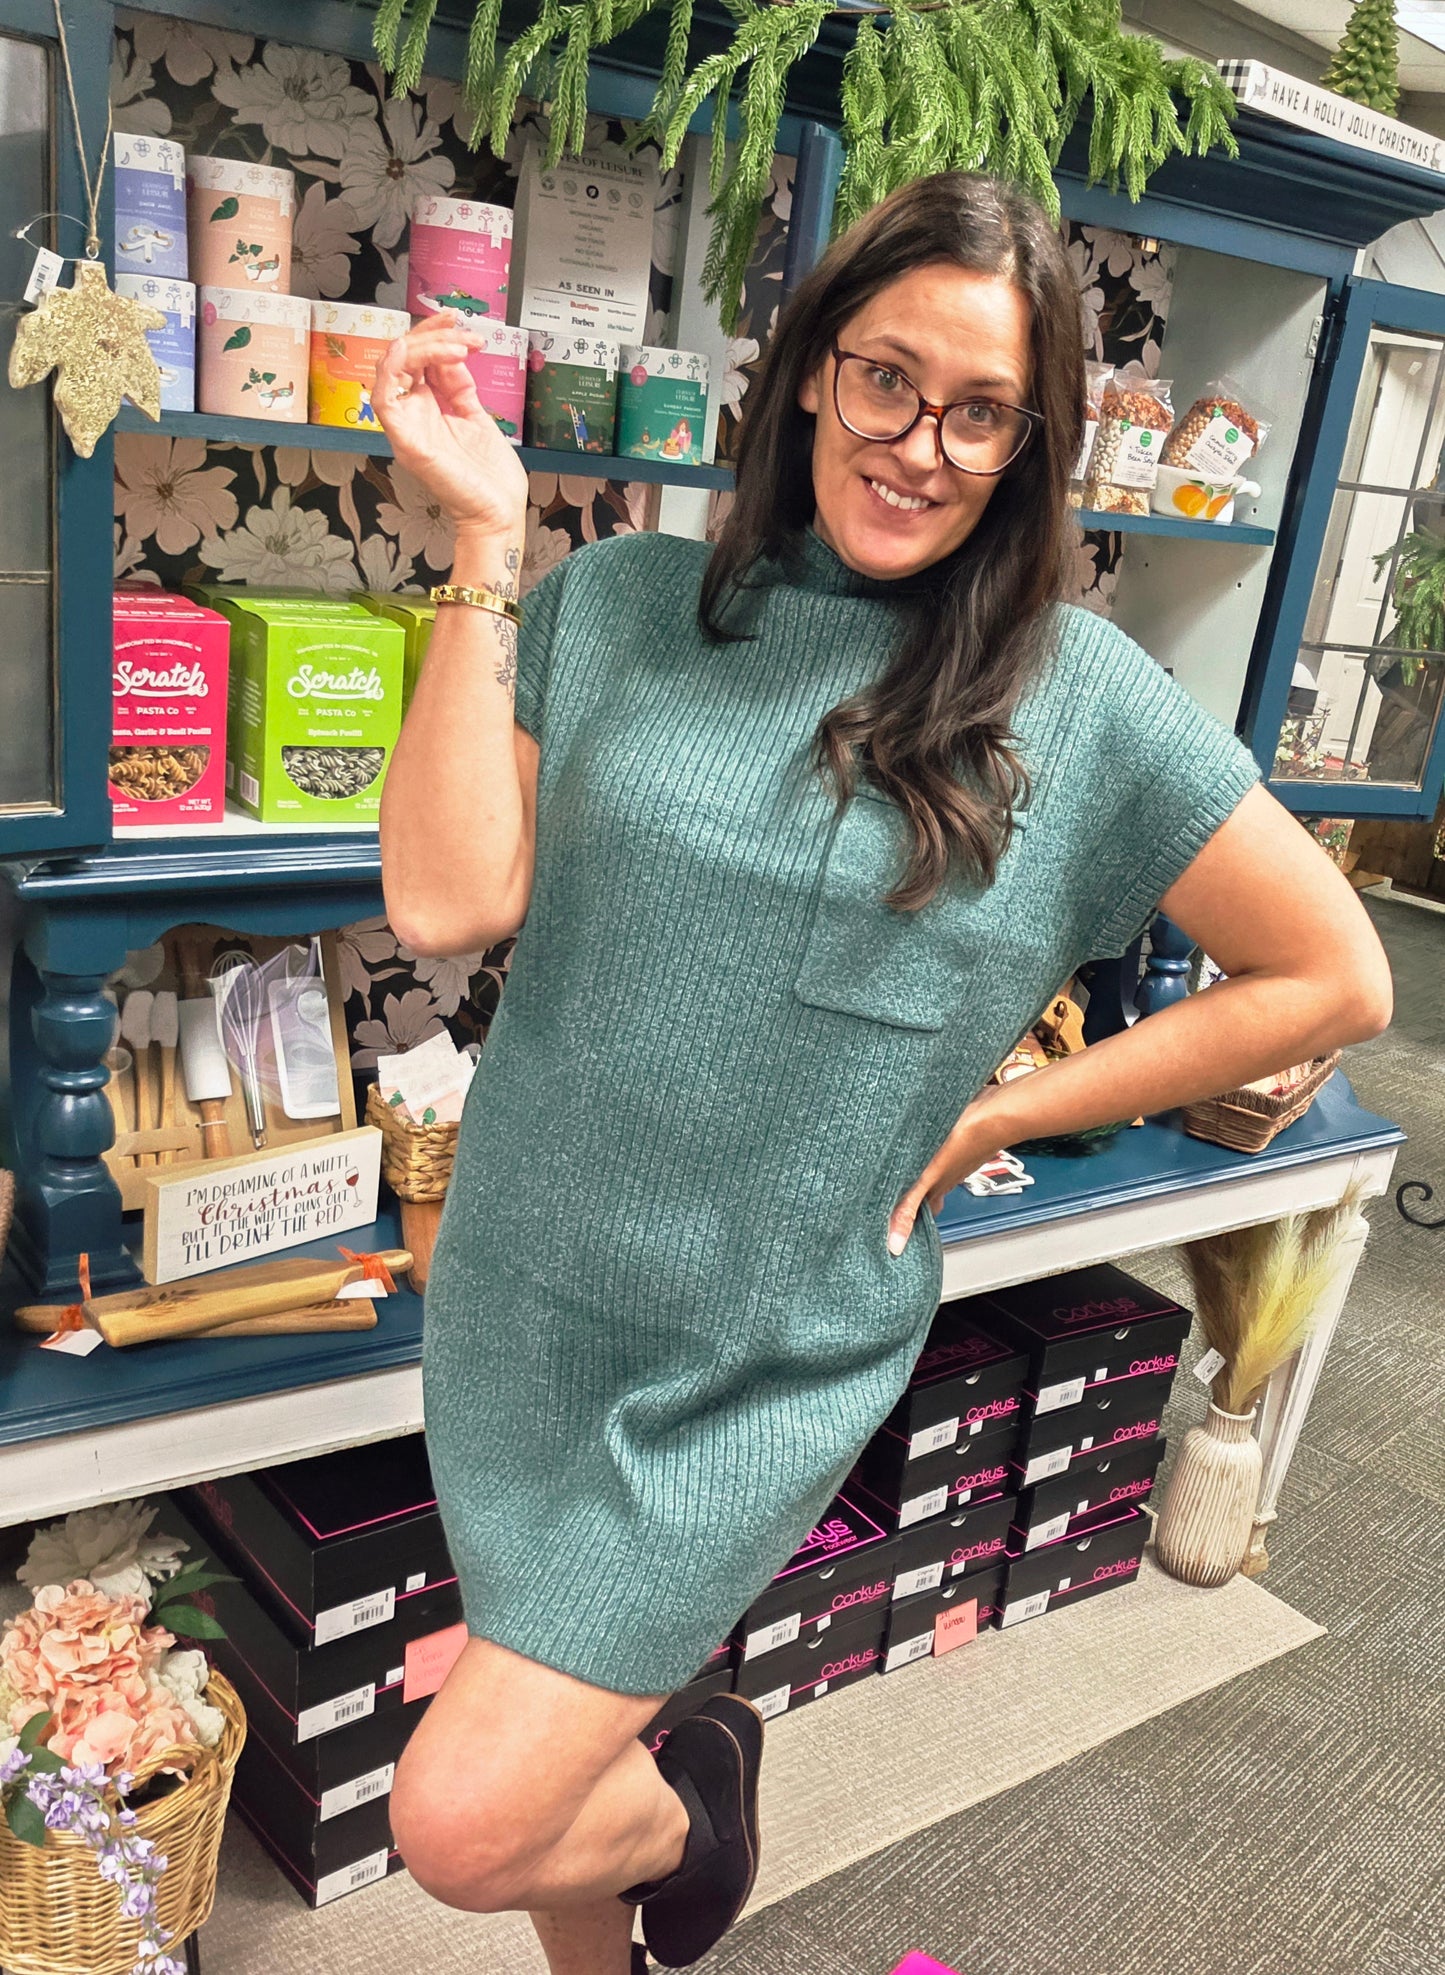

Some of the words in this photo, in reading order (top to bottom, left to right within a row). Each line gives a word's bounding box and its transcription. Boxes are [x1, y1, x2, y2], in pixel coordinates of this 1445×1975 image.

[1271, 81, 1300, 110] HAVE
[1303, 96, 1309, 113] A
[1313, 99, 1345, 129] HOLLY
[1347, 114, 1377, 141] JOLLY
[1378, 127, 1429, 162] CHRISTMAS
[600, 160, 645, 177] LEISURE
[559, 281, 572, 290] AS
[576, 284, 601, 295] SEEN
[604, 288, 615, 297] IN
[571, 316, 595, 328] Forbes
[112, 661, 209, 697] Scratch
[287, 664, 385, 700] Scratch
[136, 706, 165, 715] PASTA
[167, 706, 180, 715] Co
[316, 708, 343, 717] PASTA
[344, 709, 356, 717] Co
[186, 1189, 208, 1207] I'M
[212, 1171, 277, 1202] DREAMING
[282, 1166, 296, 1184] OF
[300, 1163, 308, 1179] A
[313, 1153, 350, 1176] WHITE
[198, 1178, 340, 1226] Christmas
[182, 1227, 207, 1246] BUT
[213, 1222, 222, 1237] IF
[229, 1216, 249, 1233] THE
[254, 1204, 289, 1227] WHITE
[294, 1196, 322, 1215] RUNS
[184, 1241, 213, 1265] I'LL
[220, 1223, 275, 1255] DRINK
[281, 1214, 308, 1237] THE
[315, 1204, 344, 1227] RED
[1129, 1354, 1175, 1375] Corkys
[966, 1397, 1015, 1422] Corkys
[1113, 1420, 1157, 1441] Corkys
[955, 1465, 1004, 1490] Corkys
[1109, 1478, 1151, 1501] Corkys
[822, 1535, 858, 1551] Footwear
[951, 1538, 1002, 1562] Corkys
[1093, 1557, 1137, 1580] Corkys
[832, 1581, 886, 1610] Corkys
[821, 1648, 874, 1679] Corkys
